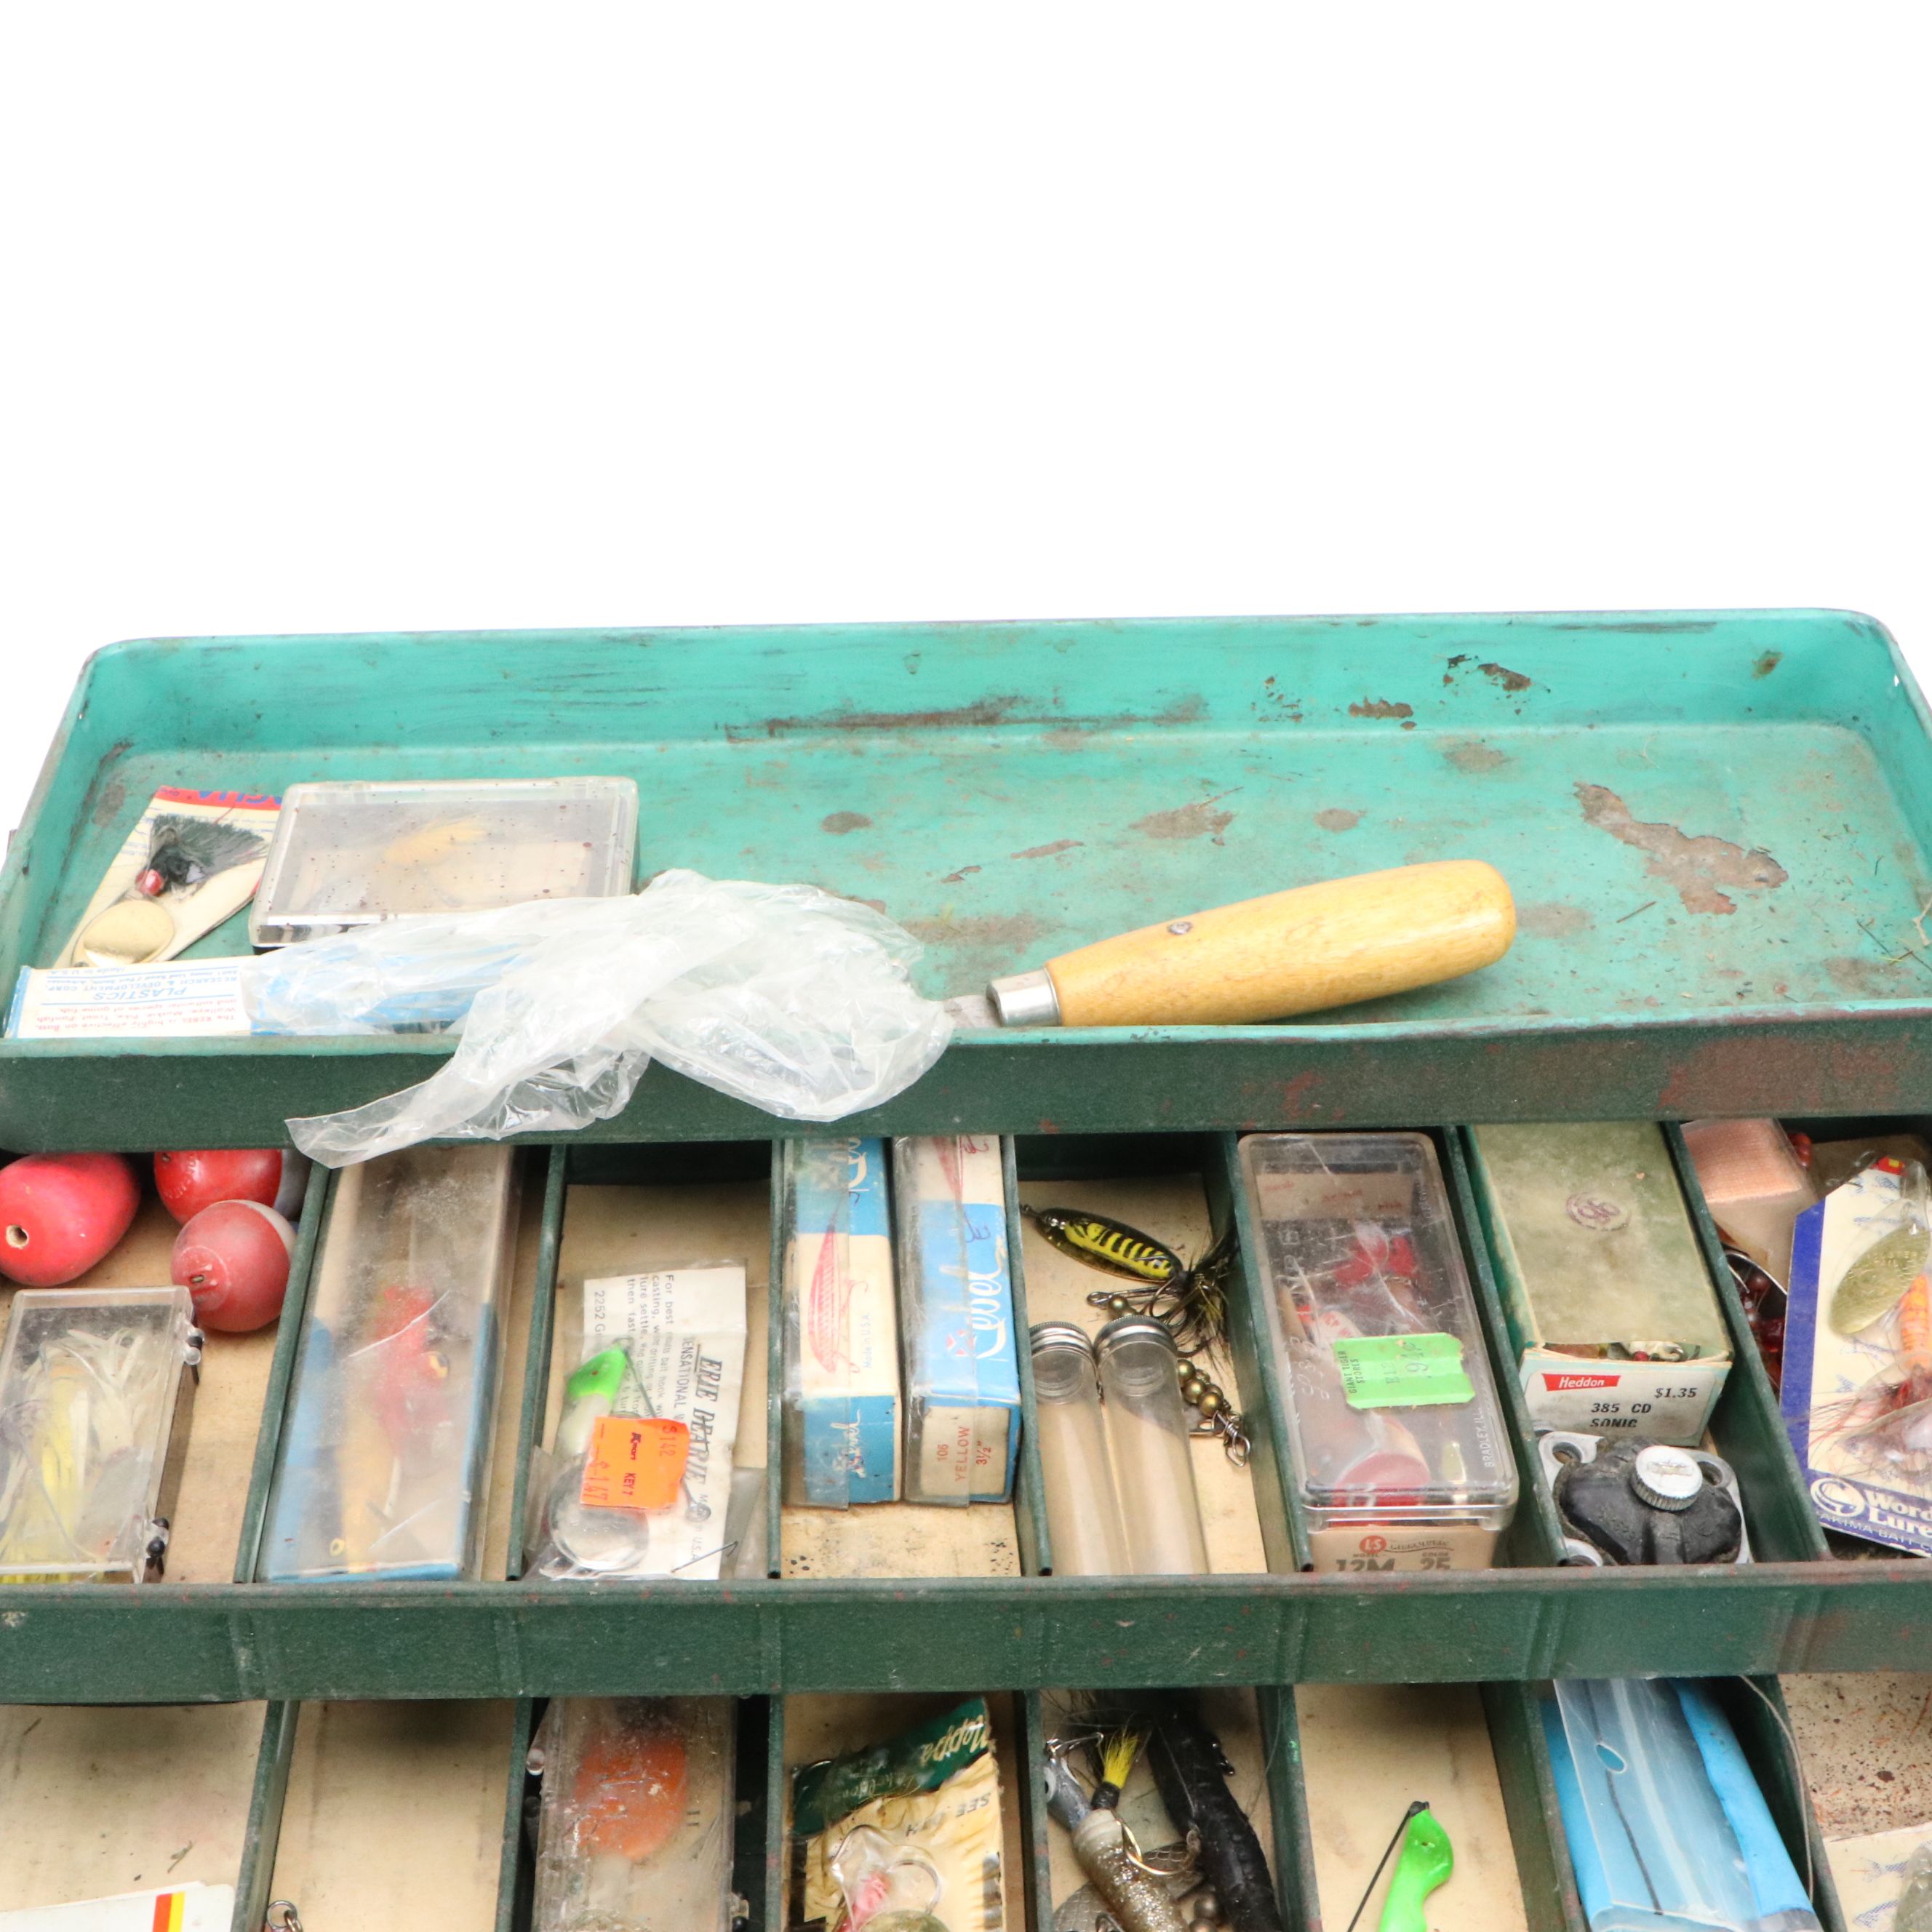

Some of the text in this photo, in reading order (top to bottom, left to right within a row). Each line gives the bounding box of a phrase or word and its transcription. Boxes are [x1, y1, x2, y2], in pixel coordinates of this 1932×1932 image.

[83, 982, 161, 991] DEVELOPMENT
[180, 977, 238, 985] RESEARCH
[92, 987, 188, 1001] PLASTICS
[627, 1279, 636, 1304] then
[639, 1277, 648, 1298] lure
[665, 1274, 674, 1294] For
[594, 1290, 606, 1320] 2252
[651, 1275, 660, 1319] casting,
[939, 1235, 1007, 1360] Rebel
[627, 1312, 636, 1333] fast
[665, 1301, 674, 1324] best
[863, 1346, 873, 1368] Made
[1337, 1350, 1351, 1370] TIGER
[695, 1357, 722, 1402] ERIE
[1349, 1359, 1365, 1384] STORES
[1344, 1373, 1358, 1394] GIANT
[1558, 1376, 1605, 1389] Heddon
[1654, 1387, 1698, 1398] $1.35
[1591, 1403, 1651, 1413] 385 CD
[1590, 1418, 1638, 1428] SONIC
[629, 1432, 642, 1461] Kmart
[683, 1408, 715, 1484] DEARIE
[955, 1426, 970, 1481] YELLOW
[623, 1473, 636, 1488] KEY
[1817, 1512, 1873, 1533] AKIMA
[1879, 1529, 1912, 1545] BAIT
[1336, 1558, 1395, 1571] 12M
